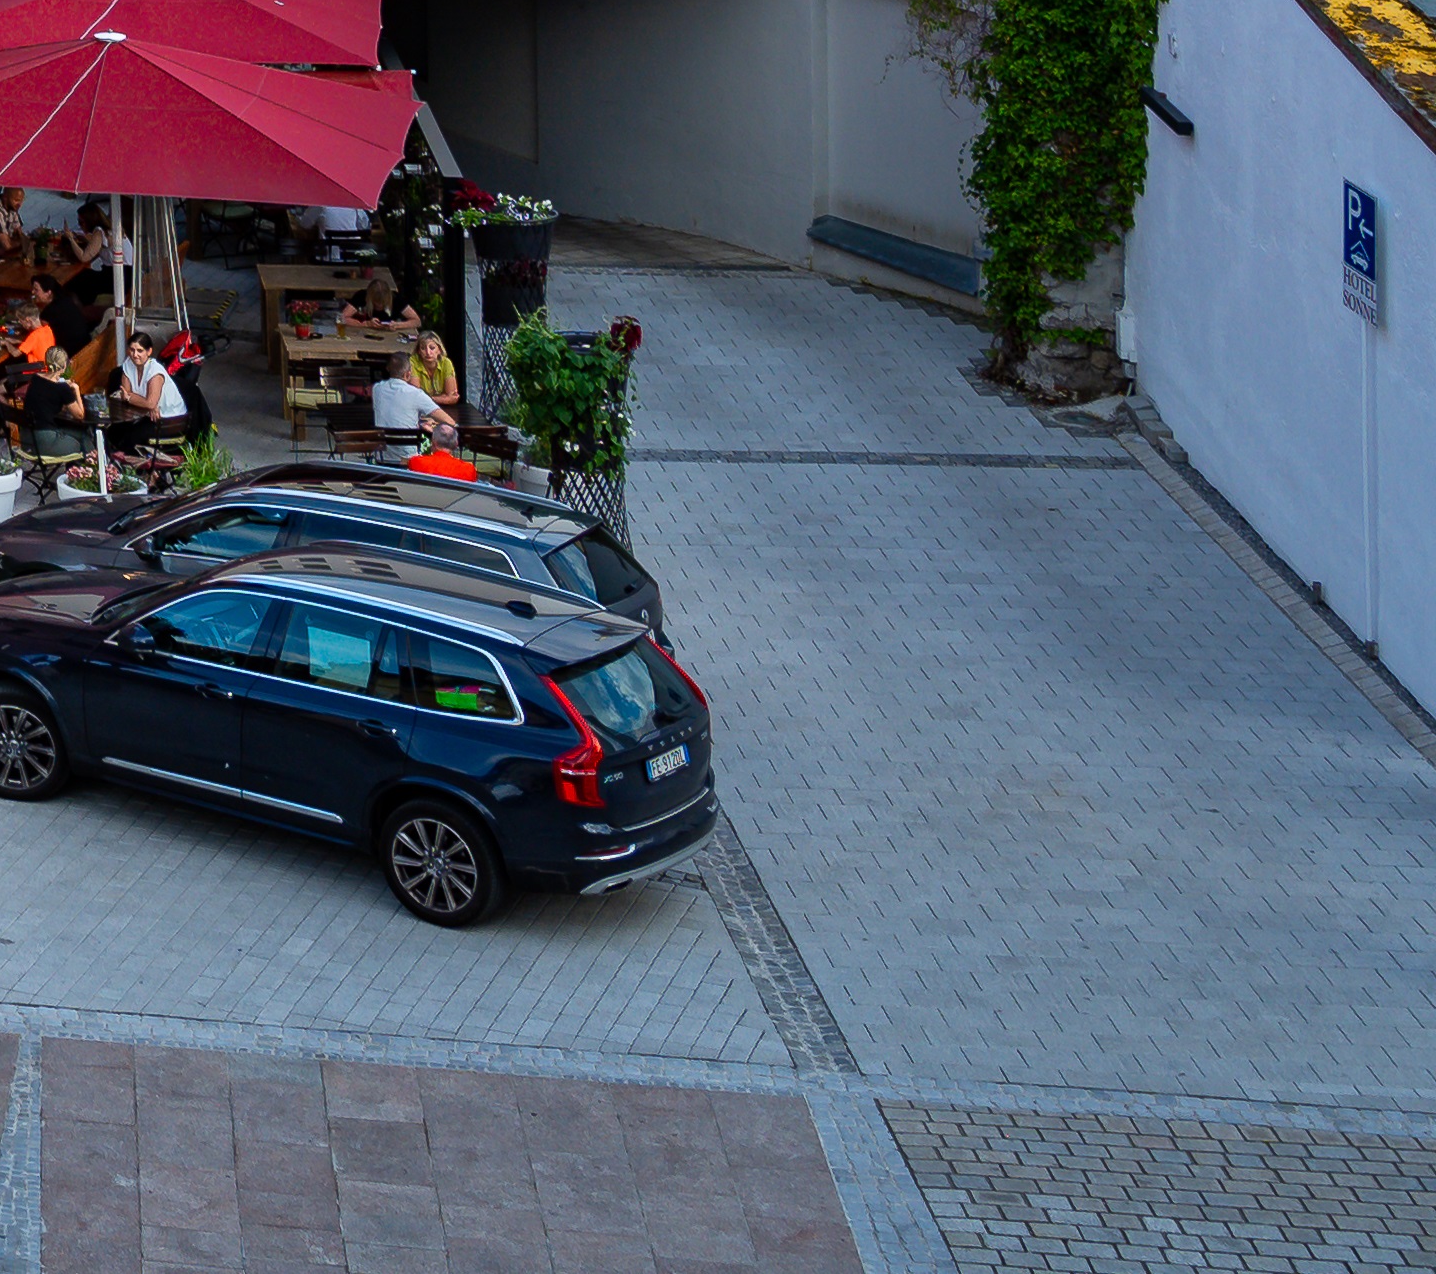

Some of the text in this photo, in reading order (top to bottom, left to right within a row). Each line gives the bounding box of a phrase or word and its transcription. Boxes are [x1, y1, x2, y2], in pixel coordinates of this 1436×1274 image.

[1348, 188, 1362, 230] P
[1343, 266, 1377, 303] HOTEL
[1342, 290, 1378, 328] SONNE
